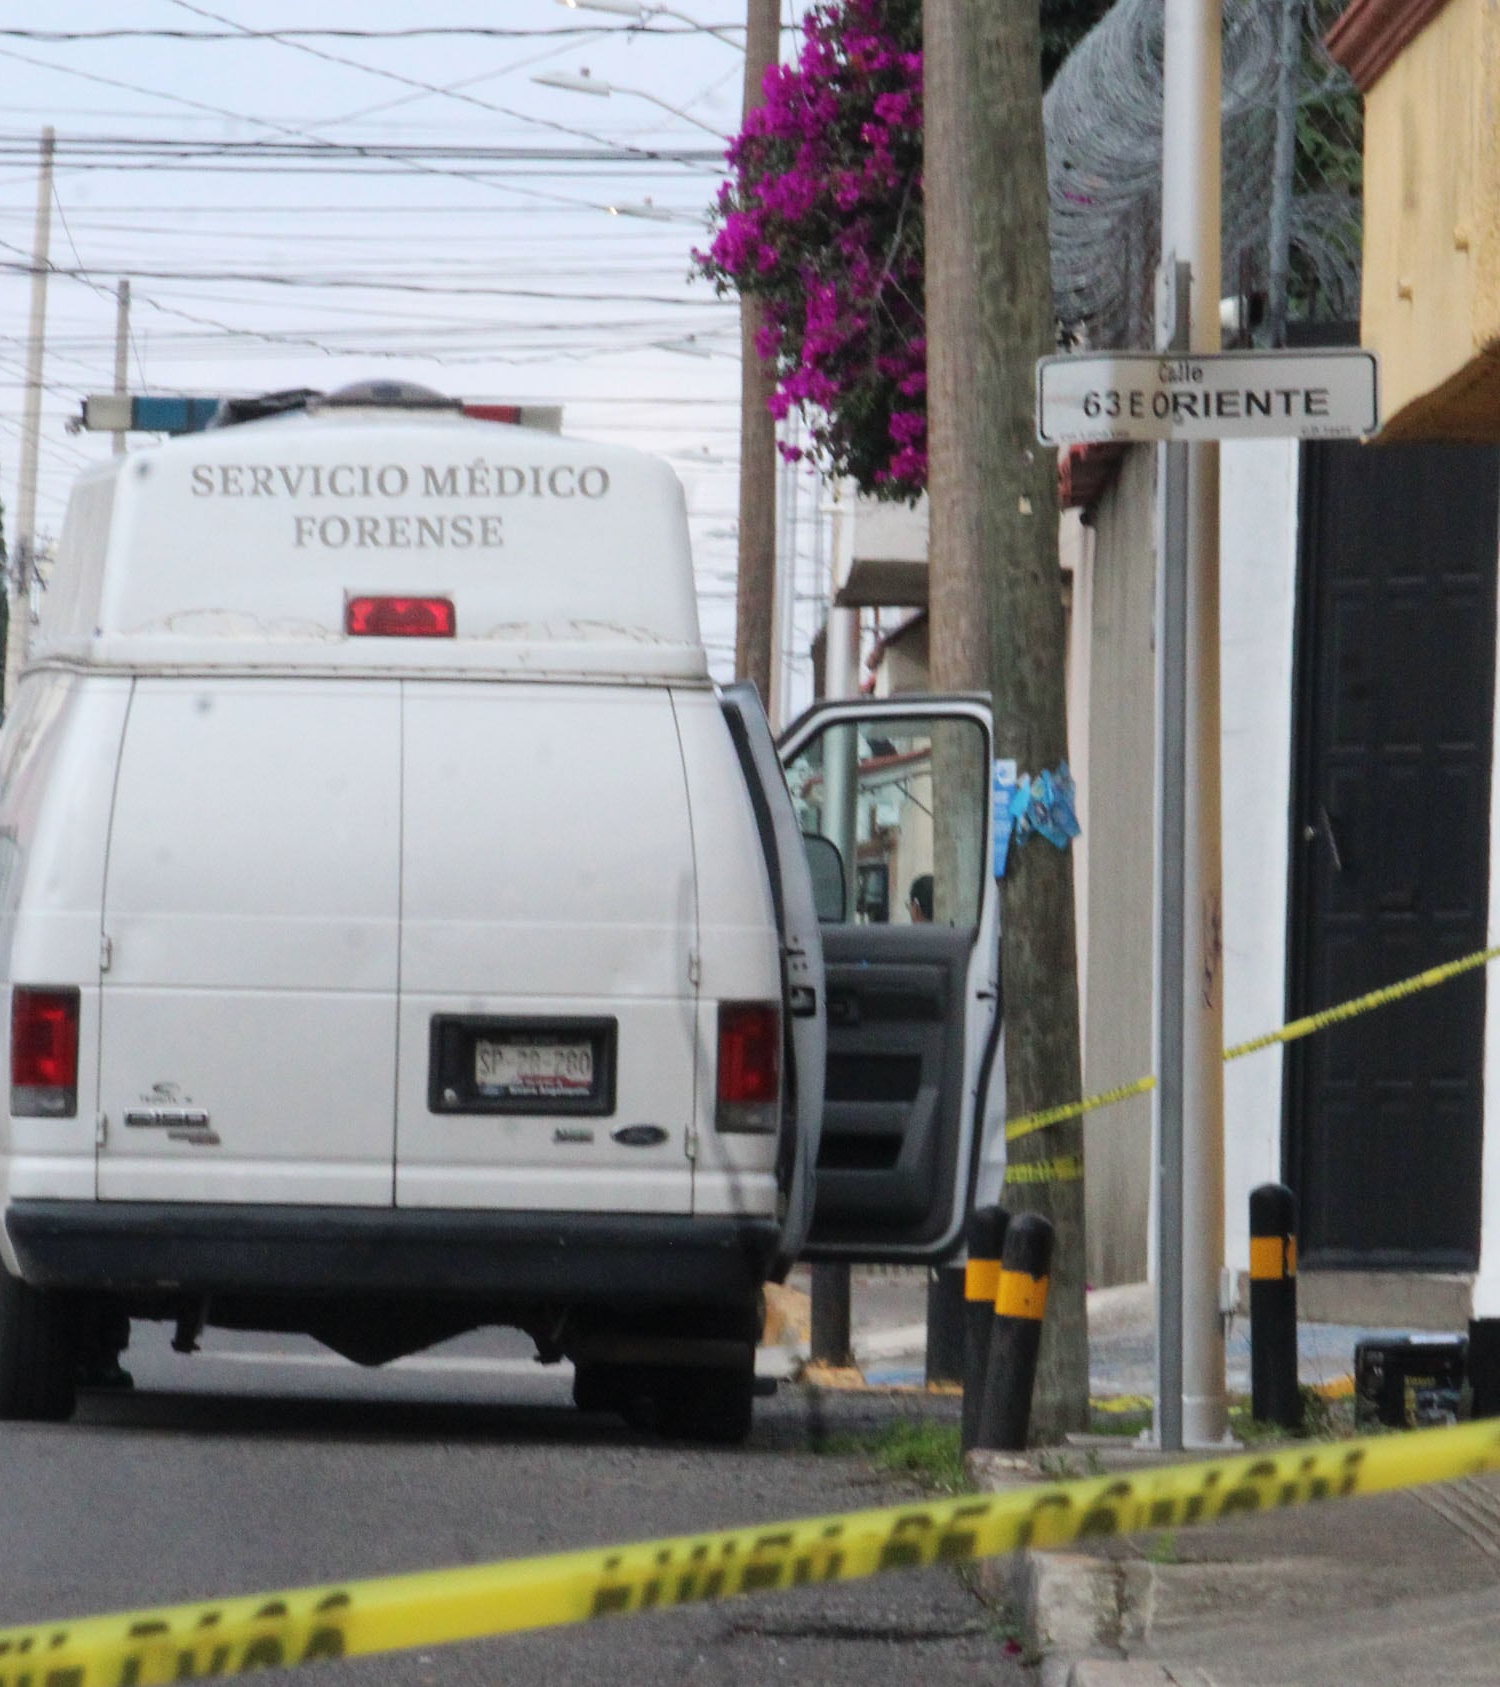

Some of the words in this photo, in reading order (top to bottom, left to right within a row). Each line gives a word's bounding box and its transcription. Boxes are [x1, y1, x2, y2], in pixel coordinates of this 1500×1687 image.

[1152, 388, 1331, 419] ORIENTE
[190, 463, 410, 500] SERVICIO
[423, 457, 612, 499] MÉDICO
[293, 514, 505, 550] FORENSE
